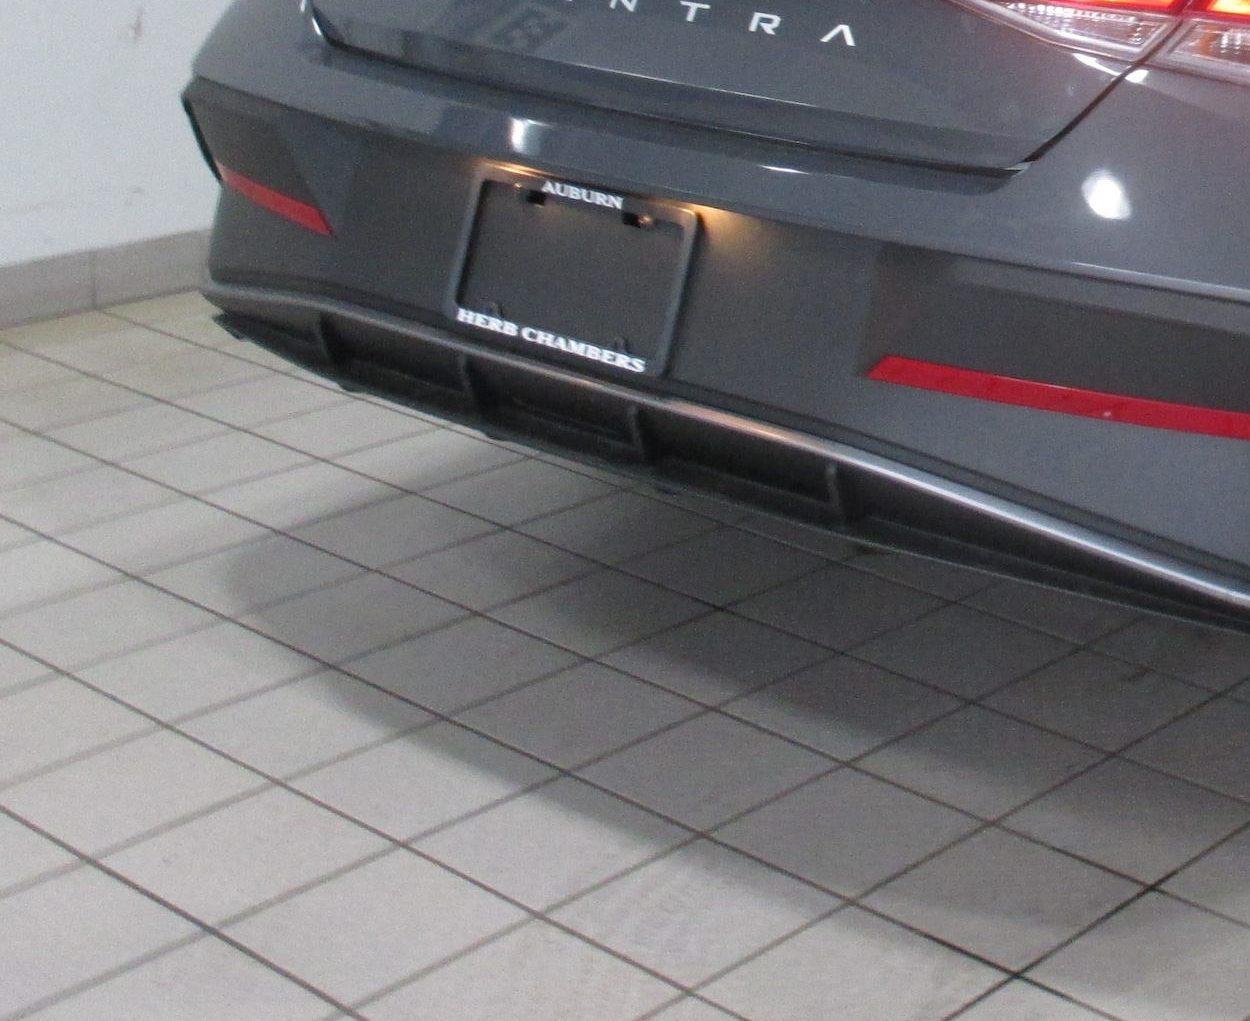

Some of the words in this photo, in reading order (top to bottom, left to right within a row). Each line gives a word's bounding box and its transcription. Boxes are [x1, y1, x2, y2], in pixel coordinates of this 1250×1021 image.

[541, 180, 624, 210] AUBURN
[455, 307, 519, 337] HERB
[521, 326, 646, 373] CHAMBERS
